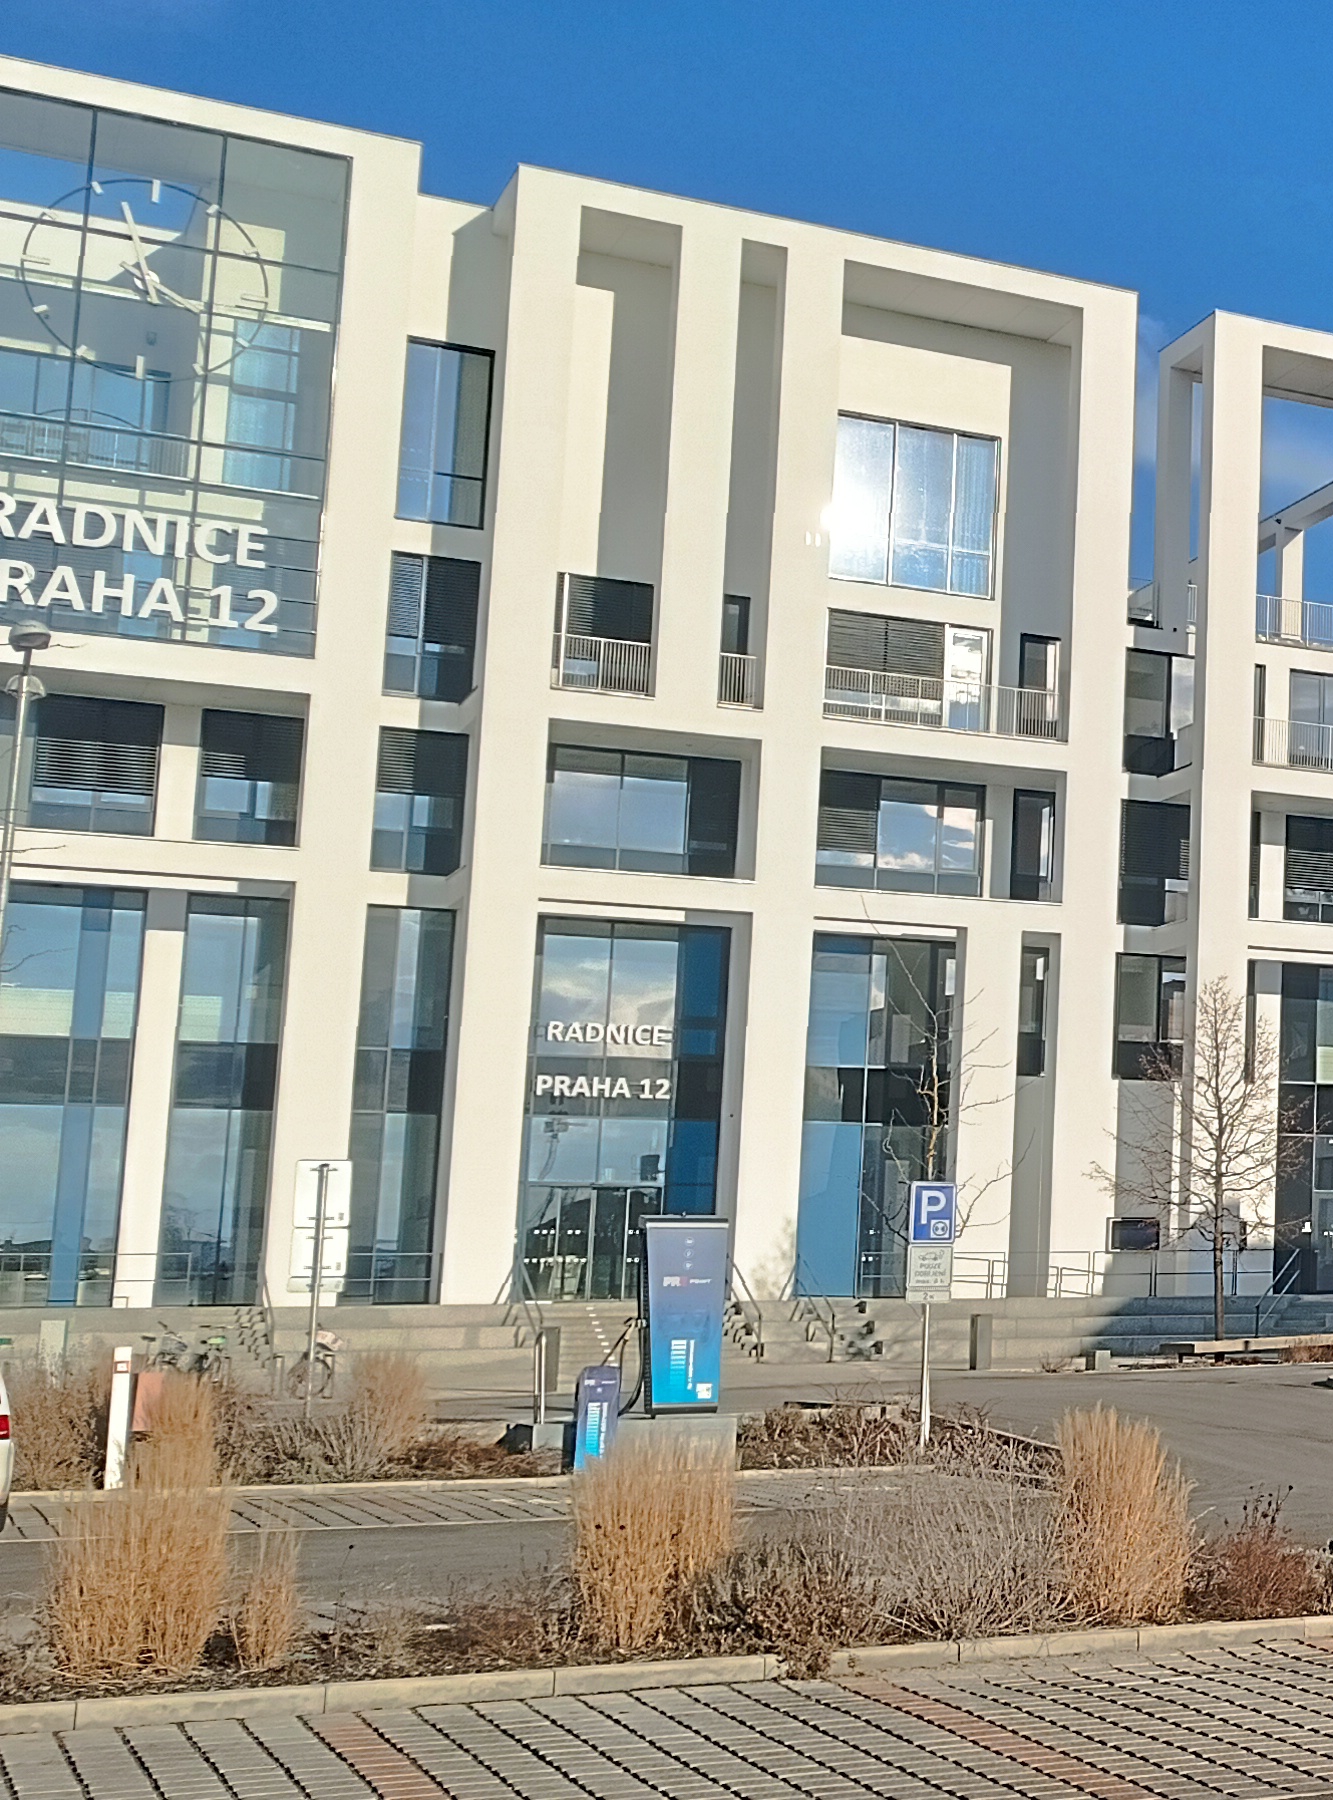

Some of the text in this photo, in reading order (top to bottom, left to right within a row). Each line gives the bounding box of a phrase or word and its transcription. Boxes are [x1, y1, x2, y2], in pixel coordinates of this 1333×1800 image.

[208, 585, 278, 633] 12
[547, 1020, 672, 1045] RADNICE
[536, 1075, 671, 1100] PRAHA 12
[921, 1190, 946, 1224] P
